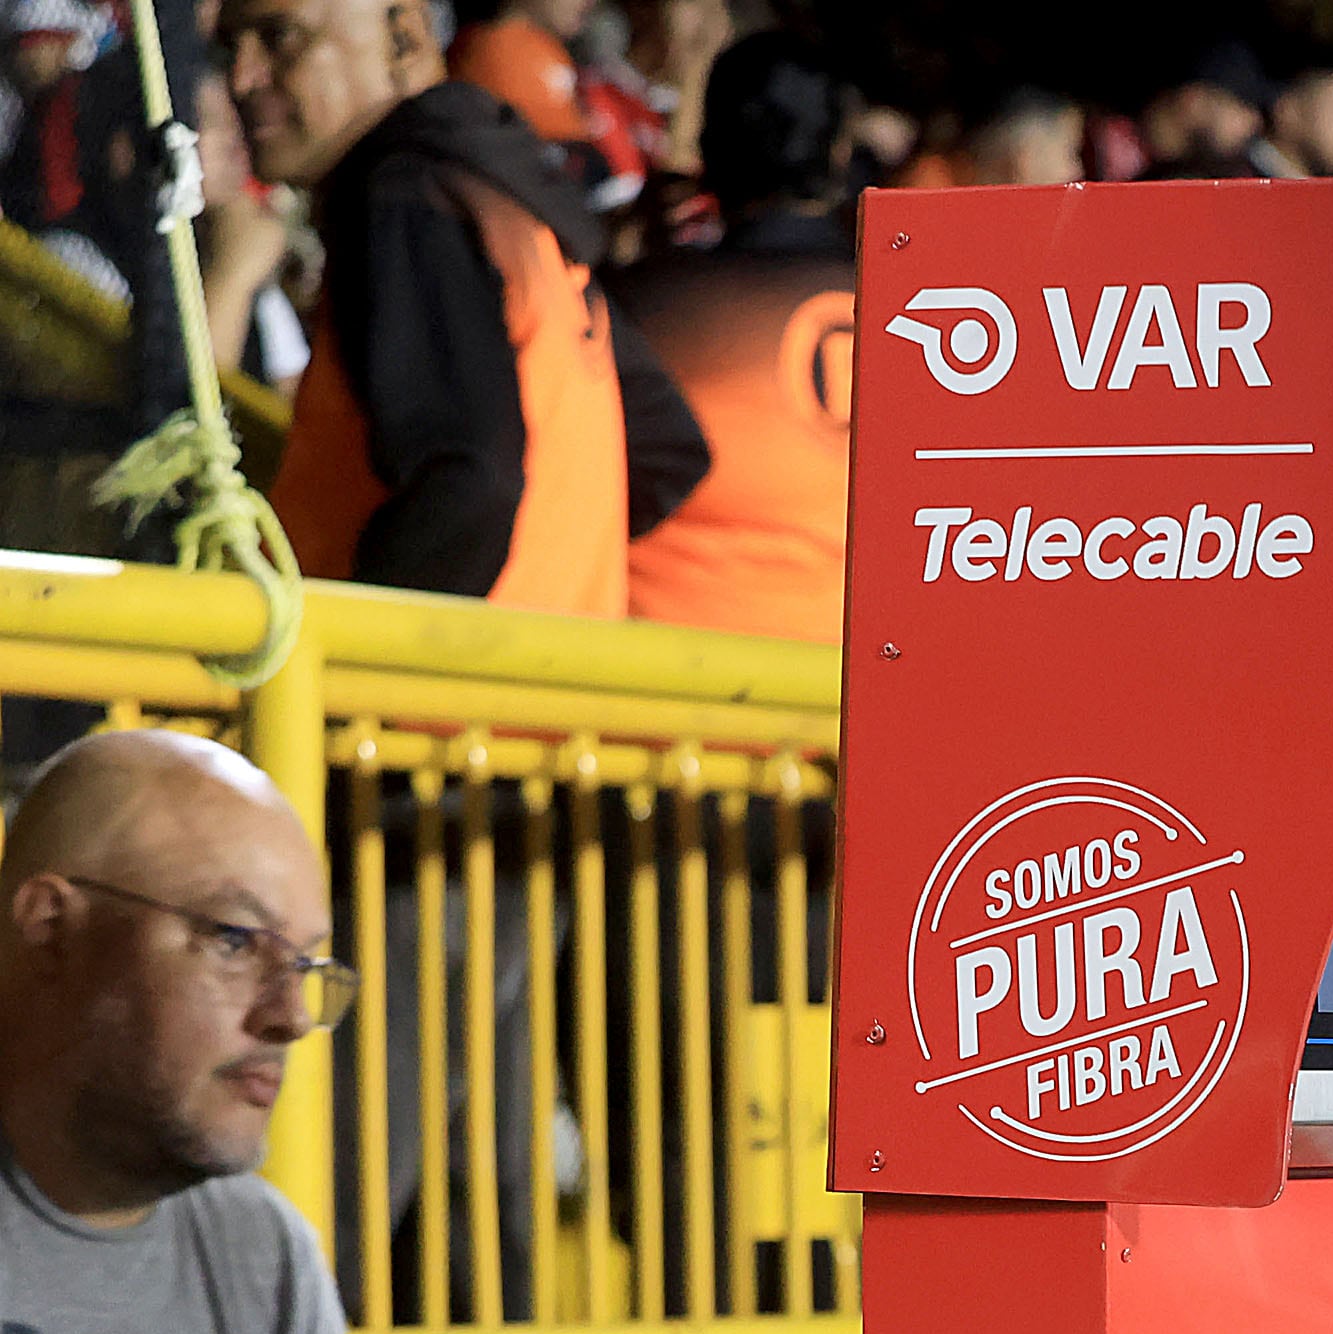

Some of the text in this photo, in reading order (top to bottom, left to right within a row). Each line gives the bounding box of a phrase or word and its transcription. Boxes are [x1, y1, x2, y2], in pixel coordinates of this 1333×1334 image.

[1042, 282, 1273, 391] VAR
[913, 502, 1315, 583] Telecable
[985, 829, 1142, 920] SOMOS
[954, 885, 1219, 1061] PURA
[1025, 1024, 1183, 1121] FIBRA
